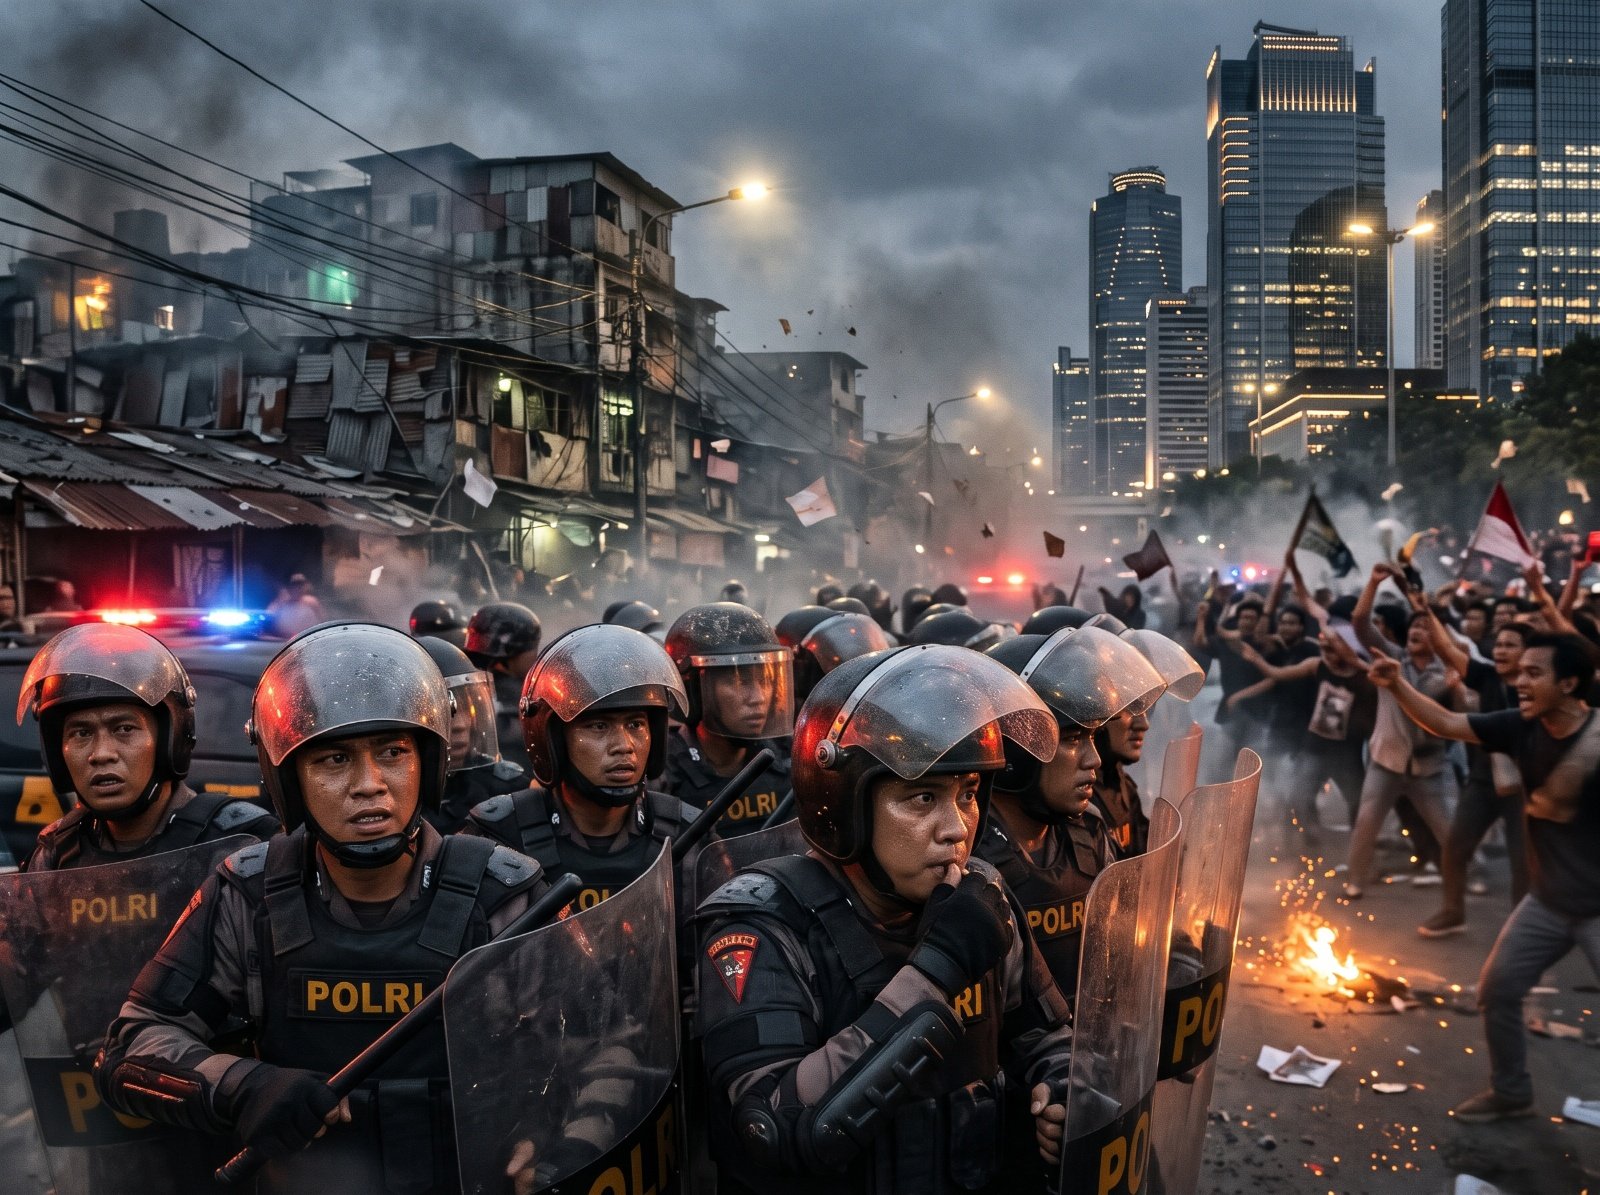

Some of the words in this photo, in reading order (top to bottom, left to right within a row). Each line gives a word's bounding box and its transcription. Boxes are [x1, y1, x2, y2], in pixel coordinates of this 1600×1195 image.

[707, 792, 777, 820] OLRI
[71, 893, 157, 924] POLRI
[307, 980, 423, 1013] POLRI
[1173, 982, 1223, 1064] PO
[60, 1071, 152, 1133] P
[1098, 1111, 1149, 1195] PO
